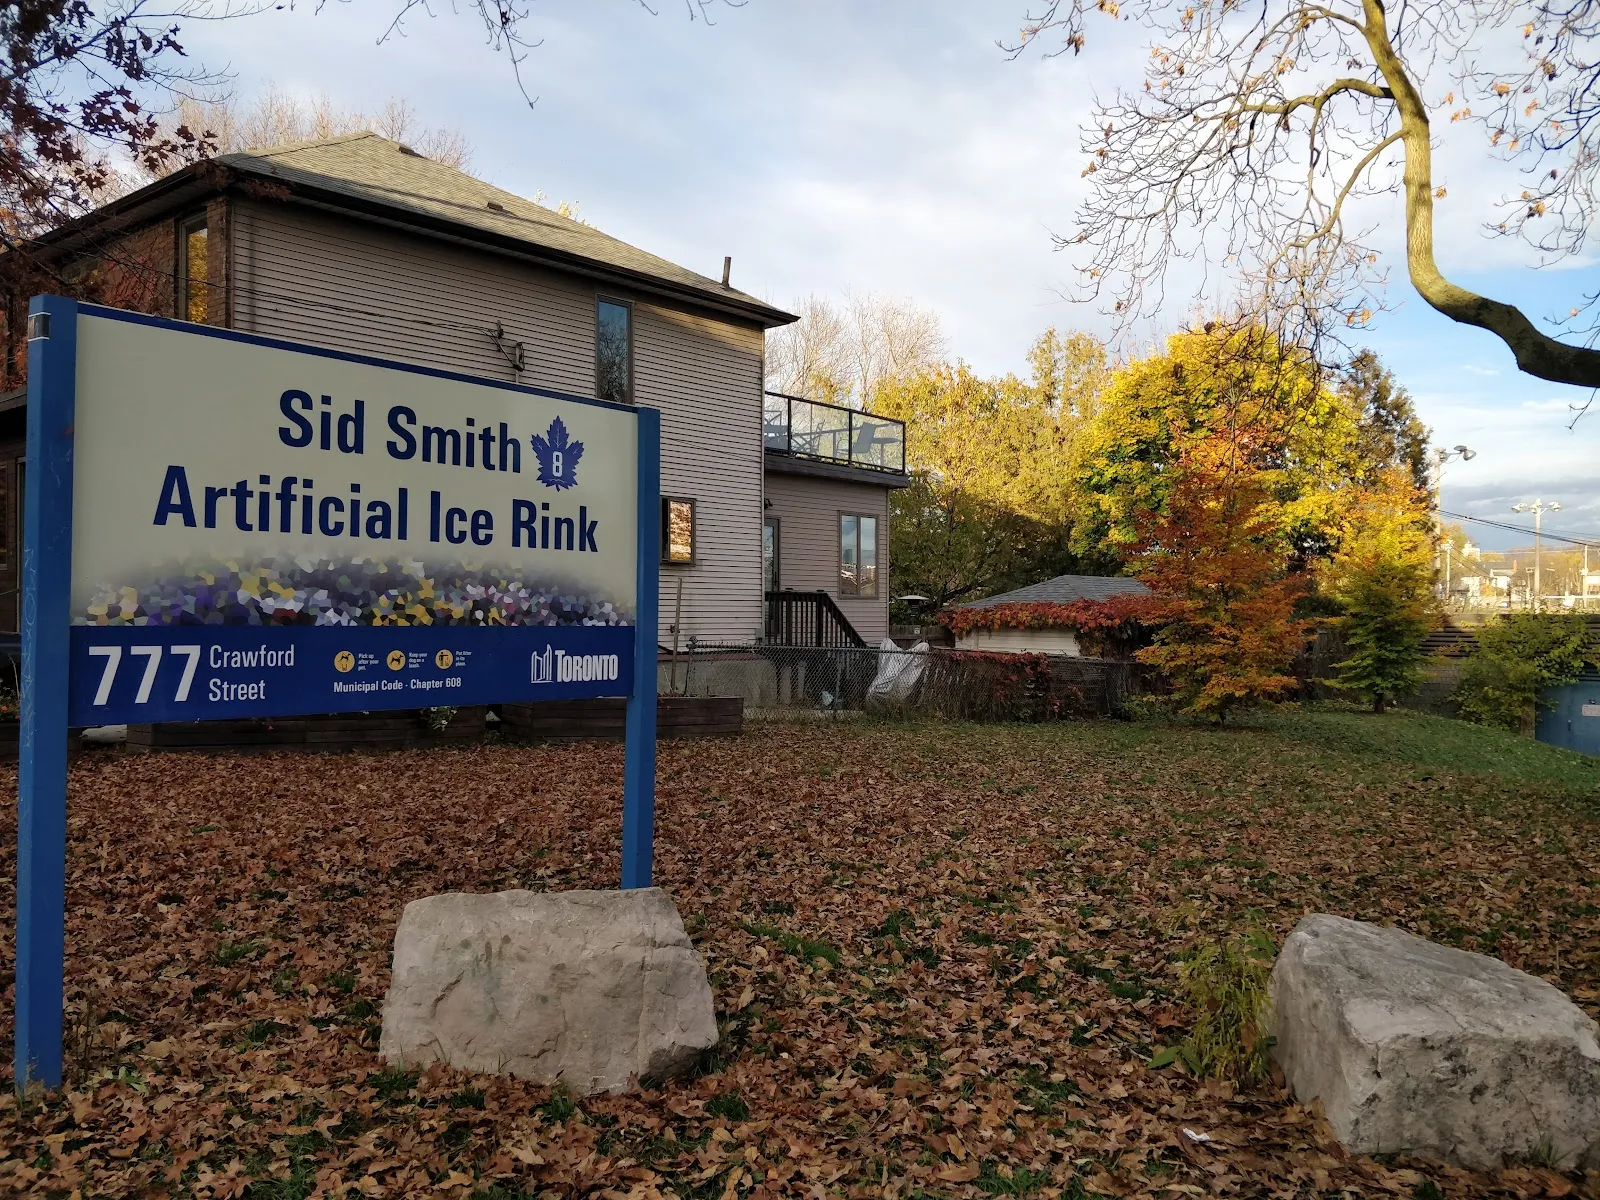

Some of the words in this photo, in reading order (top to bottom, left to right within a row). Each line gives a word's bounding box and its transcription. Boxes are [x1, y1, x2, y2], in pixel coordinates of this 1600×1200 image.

[279, 389, 364, 454] Sid
[387, 405, 521, 473] Smith
[553, 451, 563, 477] 8
[153, 465, 408, 541] Artificial
[430, 490, 494, 546] Ice
[512, 498, 599, 552] Rink
[209, 644, 295, 668] Crawford
[555, 650, 618, 682] TORONTO
[89, 645, 201, 706] 777
[208, 678, 266, 701] Street
[333, 680, 379, 693] Municipal
[381, 680, 403, 690] Code
[410, 679, 443, 690] Chapter
[445, 677, 462, 688] 608
